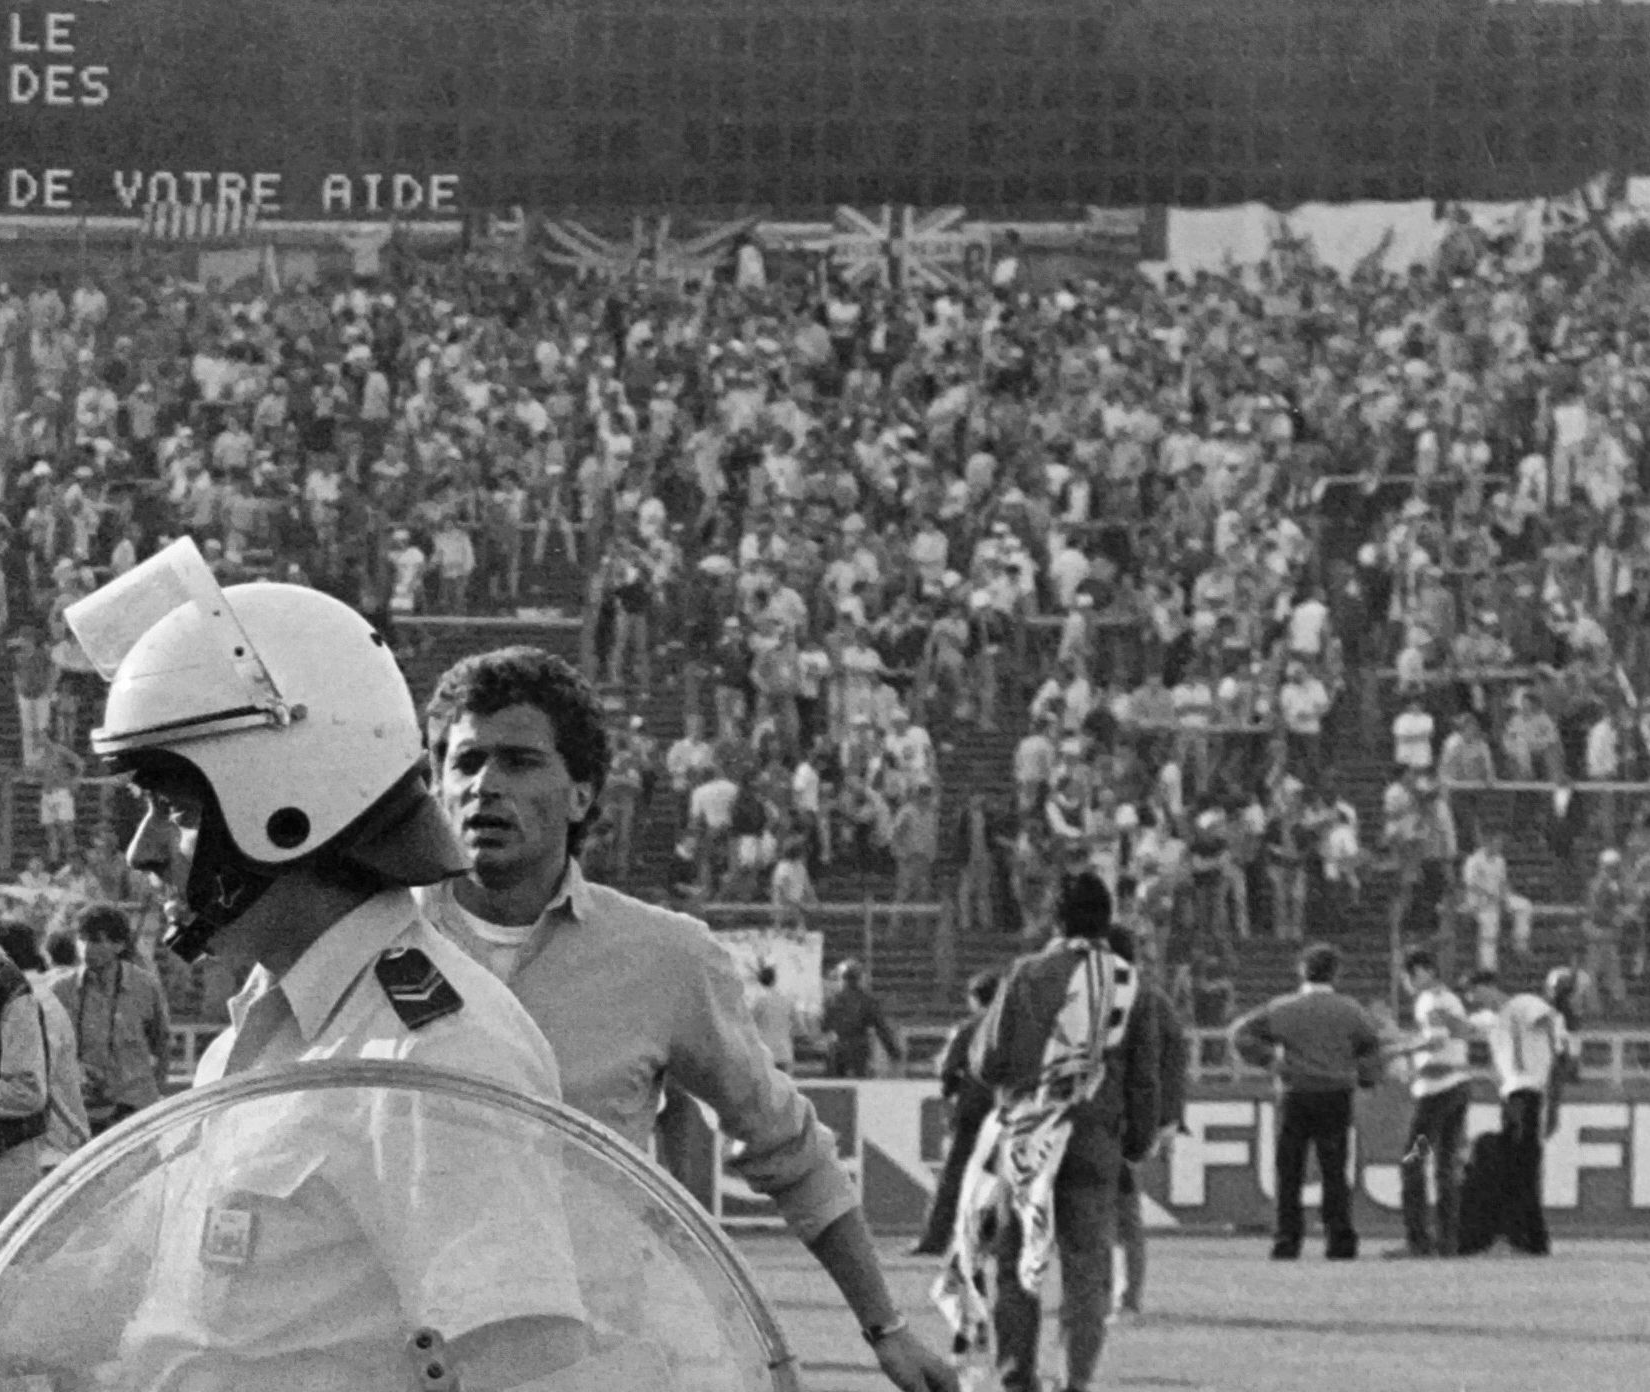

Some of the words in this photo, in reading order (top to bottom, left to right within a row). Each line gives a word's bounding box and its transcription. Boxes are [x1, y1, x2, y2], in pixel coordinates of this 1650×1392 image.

[11, 13, 75, 52] LE
[11, 64, 108, 105] DES
[10, 169, 72, 208] DE
[115, 171, 280, 211] VOTRE
[323, 174, 458, 211] AIDE
